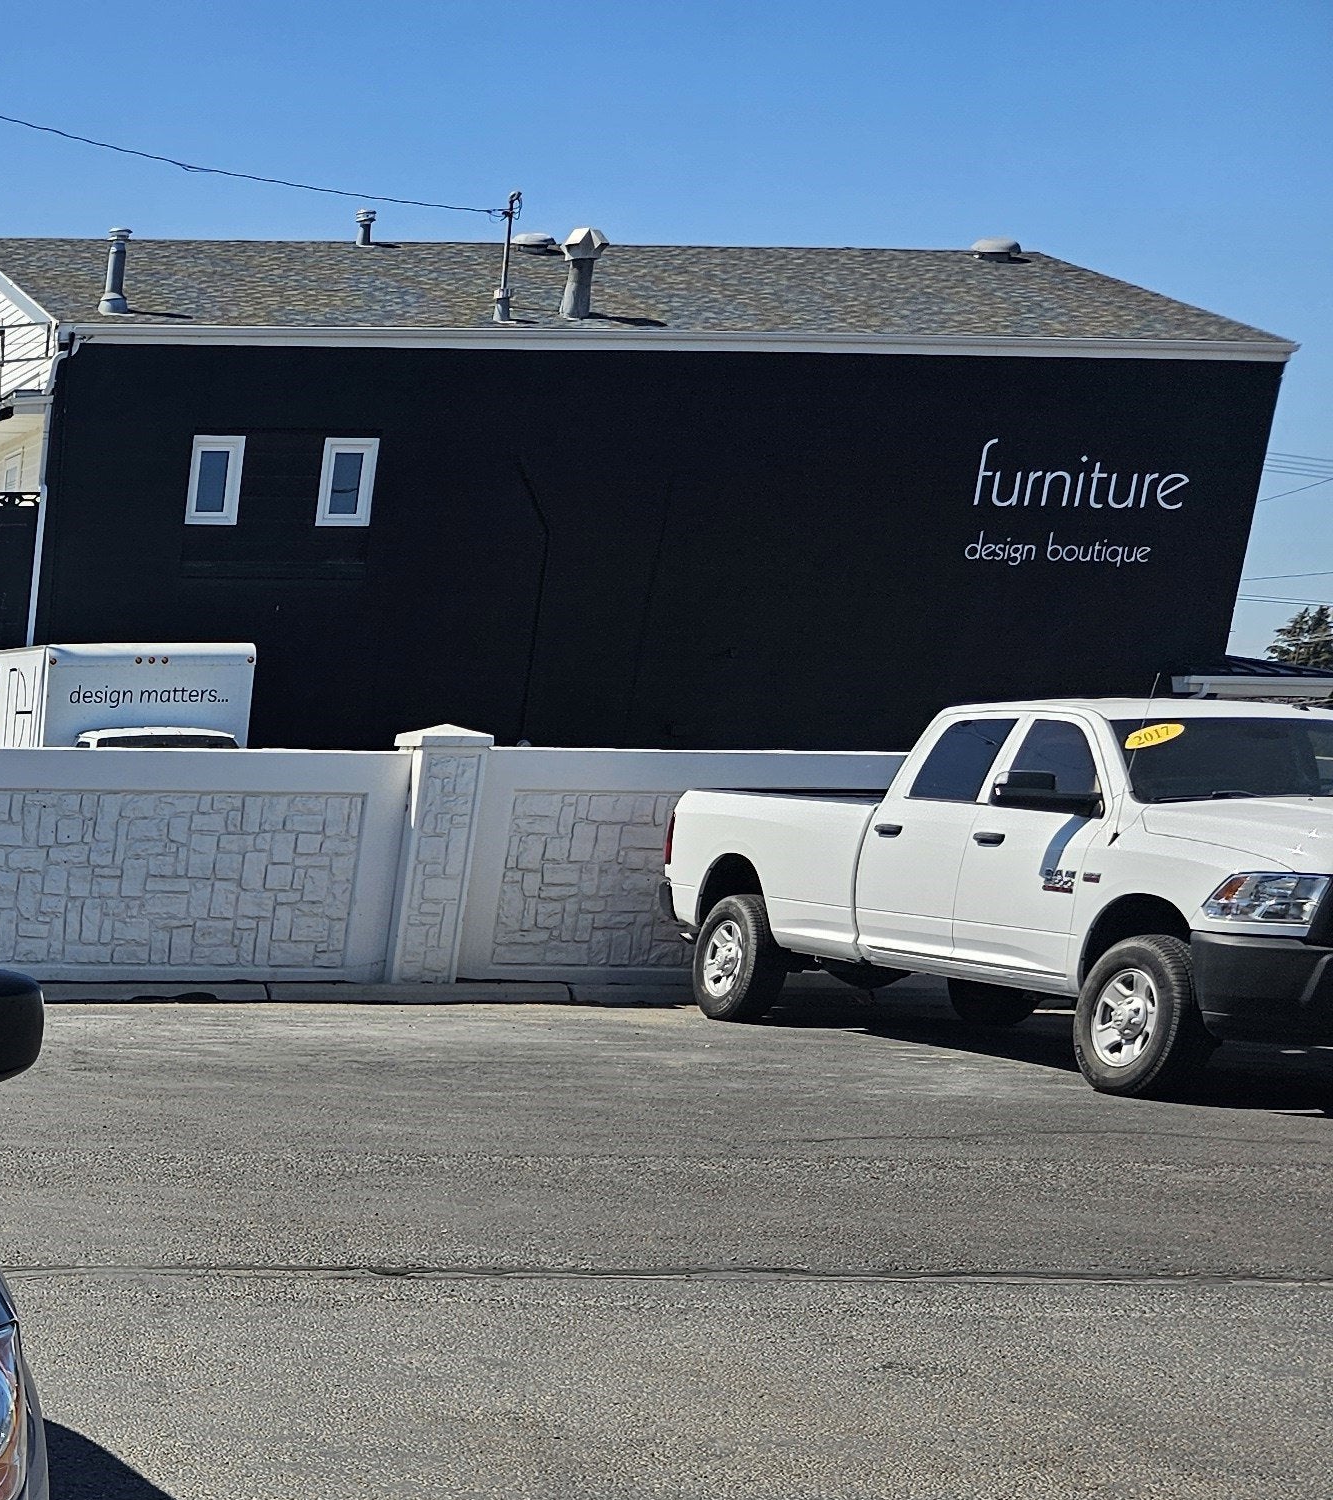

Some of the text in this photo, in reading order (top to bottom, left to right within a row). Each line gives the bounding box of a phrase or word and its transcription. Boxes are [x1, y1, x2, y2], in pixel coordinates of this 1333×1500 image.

[972, 438, 1190, 510] furniture
[965, 531, 1152, 568] design boutique
[69, 685, 230, 709] design matters...
[1134, 726, 1170, 746] 2017
